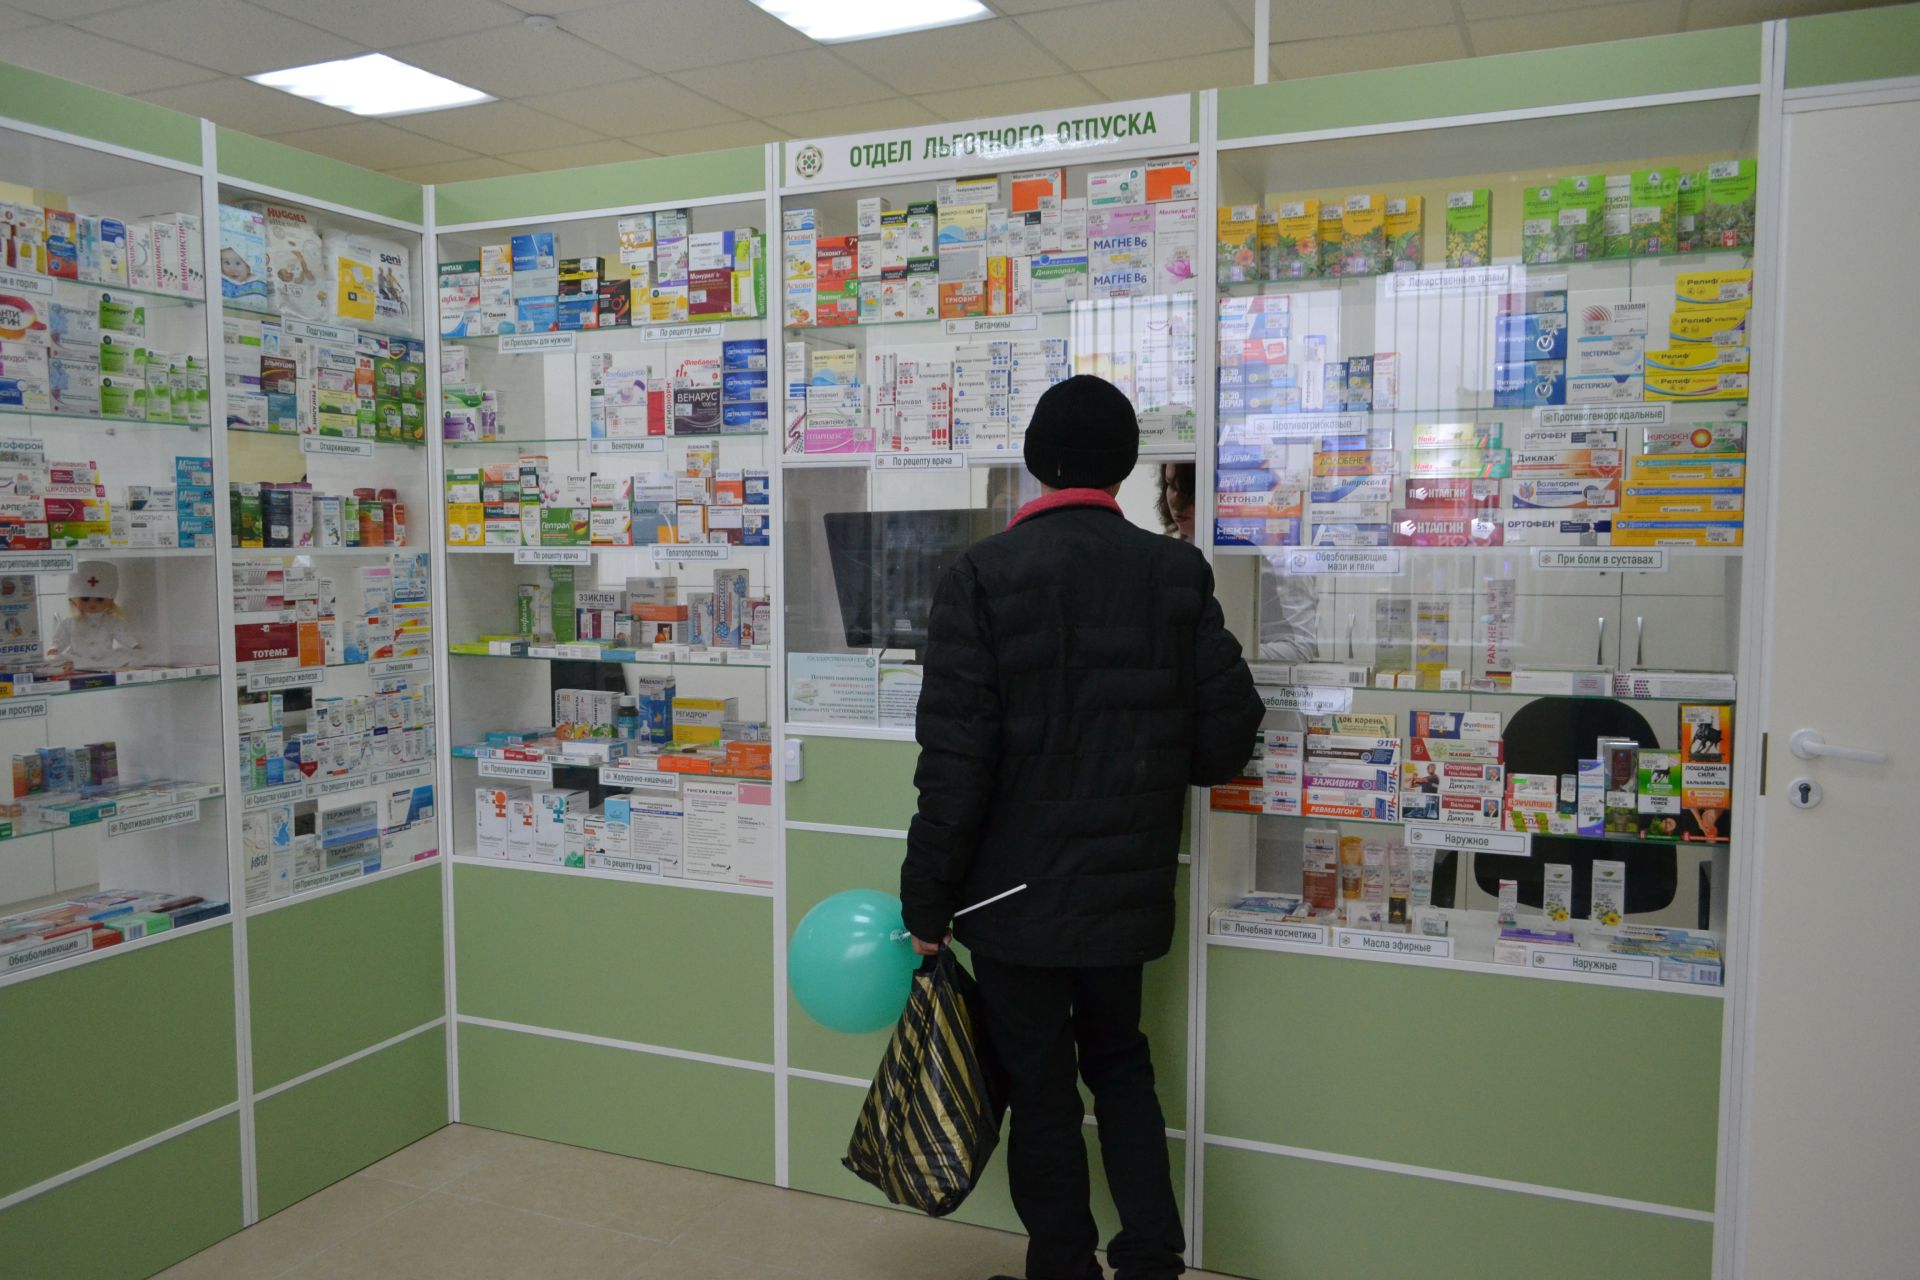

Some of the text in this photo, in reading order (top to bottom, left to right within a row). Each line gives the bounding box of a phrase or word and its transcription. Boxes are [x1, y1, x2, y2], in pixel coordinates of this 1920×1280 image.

[850, 110, 1157, 168] ОТДЕЛ ЛЬГОТНОГО ОТПУСКА
[267, 207, 307, 224] HUGGIES
[1094, 238, 1132, 250] МАГНЕ
[380, 253, 402, 266] seni
[17, 280, 38, 290] горле
[1094, 274, 1132, 286] МАГНЕ
[1409, 273, 1504, 286] Лекарственные травы
[974, 320, 1010, 330] Витамины
[306, 326, 338, 339] Подгузники
[668, 328, 690, 337] рецепту
[692, 327, 712, 335] врача
[510, 337, 538, 347] Препараты
[677, 392, 718, 402] ВЕНАРУС
[1272, 420, 1352, 431] Противогрибковые
[1648, 432, 1688, 441] НУРОФЕН
[892, 456, 952, 468] По рецепту врача
[1320, 457, 1364, 466] ДОЛОБЕНЕ
[1517, 454, 1555, 462] Диклак
[46, 486, 92, 494] ЦИКЛОФЕРОН
[1219, 494, 1264, 504] Кетонал
[1508, 520, 1555, 528] ОРТОФЕН
[542, 552, 562, 561] рецепту
[1315, 552, 1388, 563] Обезболивающие
[1558, 552, 1654, 566] При боли в суставах
[1328, 563, 1350, 572] мази
[1356, 562, 1376, 571] гели
[252, 648, 288, 658] тотема
[264, 672, 318, 686] Препараты железа
[9, 704, 44, 717] простуде
[676, 710, 708, 718] РЕГИДРОН
[490, 764, 520, 774] Препараты
[320, 778, 364, 793] По рецепту врача
[1312, 778, 1359, 788] ЗАЖИВИН
[326, 808, 362, 820] ТЕРЖИНАН
[1310, 806, 1356, 815] РЕВМАЛГОН
[1445, 834, 1489, 846] Наружное
[330, 842, 365, 857] ТЕРЖИНАН
[604, 858, 652, 871] По рецепту врача
[300, 874, 330, 889] Препараты
[1234, 924, 1317, 940] Лечебная косметика
[1363, 937, 1432, 954] Масла эфирные
[8, 941, 78, 966] Обезболивающие
[1572, 957, 1618, 972] Наружные
